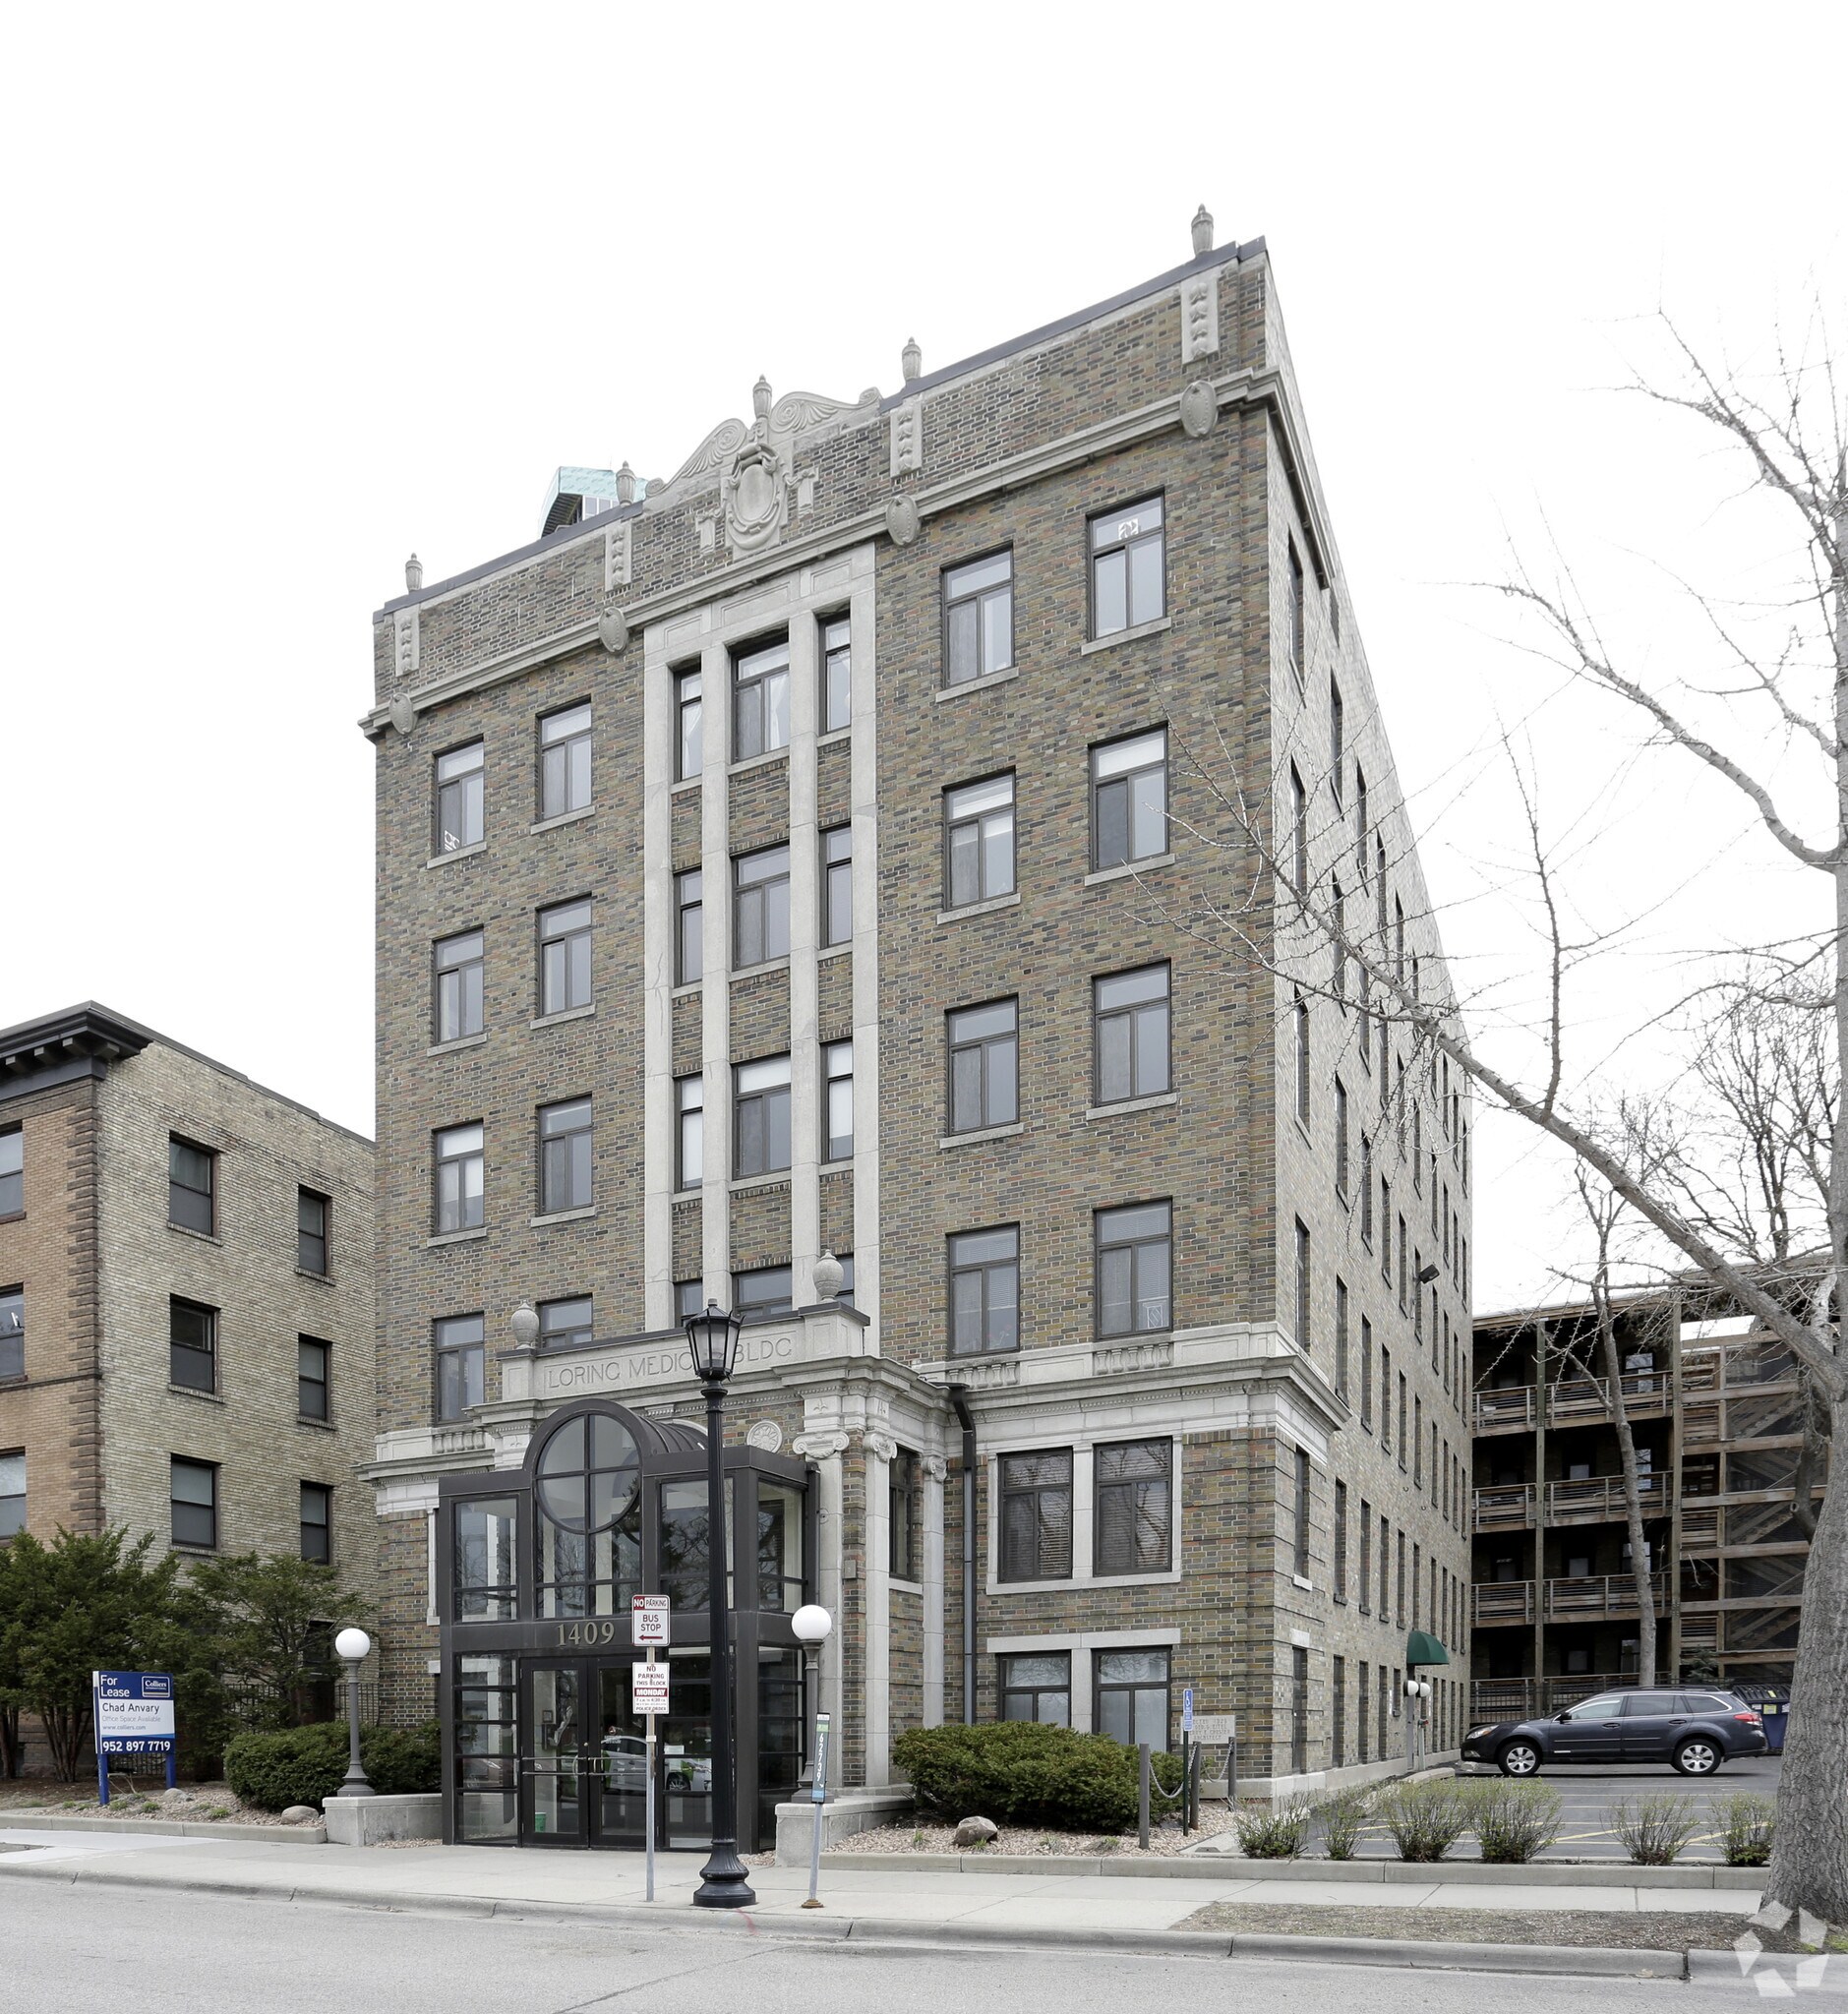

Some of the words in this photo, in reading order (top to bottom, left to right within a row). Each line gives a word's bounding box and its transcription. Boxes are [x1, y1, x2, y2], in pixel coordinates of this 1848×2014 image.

[549, 1361, 622, 1389] LORING
[628, 1351, 694, 1379] MEDIC
[633, 1597, 645, 1609] NO
[645, 1598, 667, 1608] PARKING
[642, 1614, 659, 1623] BUS
[640, 1623, 662, 1632] STOP
[557, 1622, 615, 1646] 1409
[100, 1675, 118, 1686] For
[100, 1687, 130, 1697] Lease
[102, 1702, 125, 1712] Chad
[127, 1703, 160, 1714] Anvary
[102, 1741, 123, 1751] 952
[126, 1741, 145, 1751] 897
[148, 1741, 171, 1751] 7719
